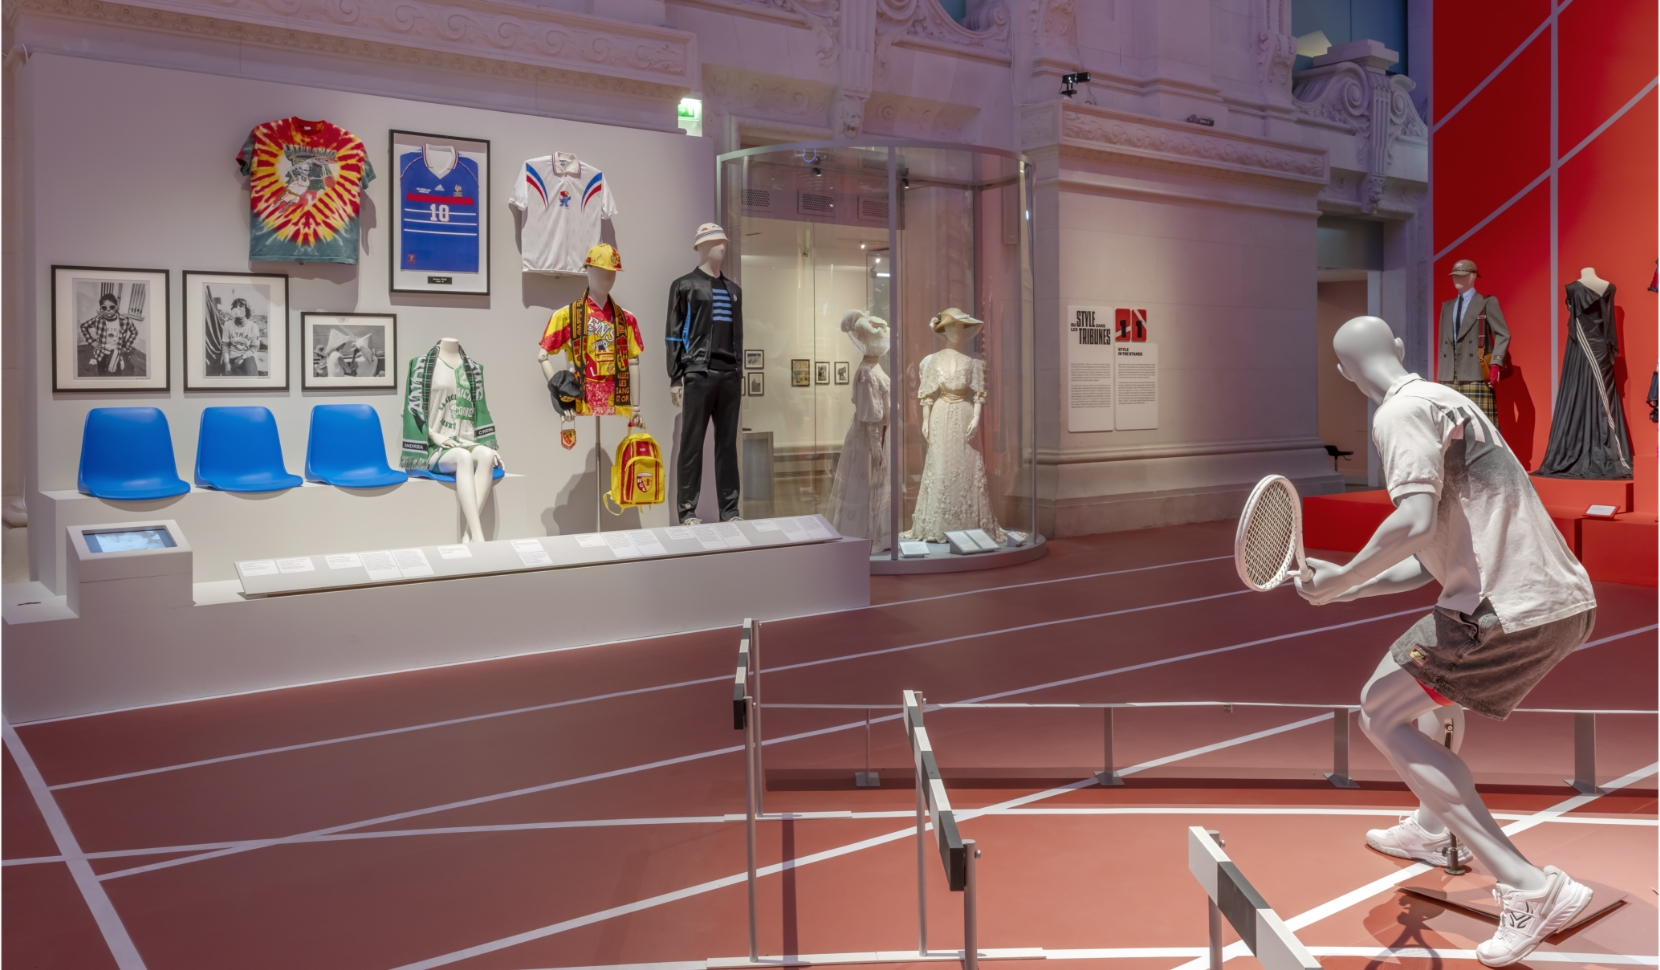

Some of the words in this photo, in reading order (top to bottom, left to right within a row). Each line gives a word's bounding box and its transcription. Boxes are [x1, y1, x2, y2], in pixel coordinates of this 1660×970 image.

[430, 204, 449, 222] 10
[1076, 311, 1095, 327] STYLE
[1079, 328, 1110, 345] TRIBUNES
